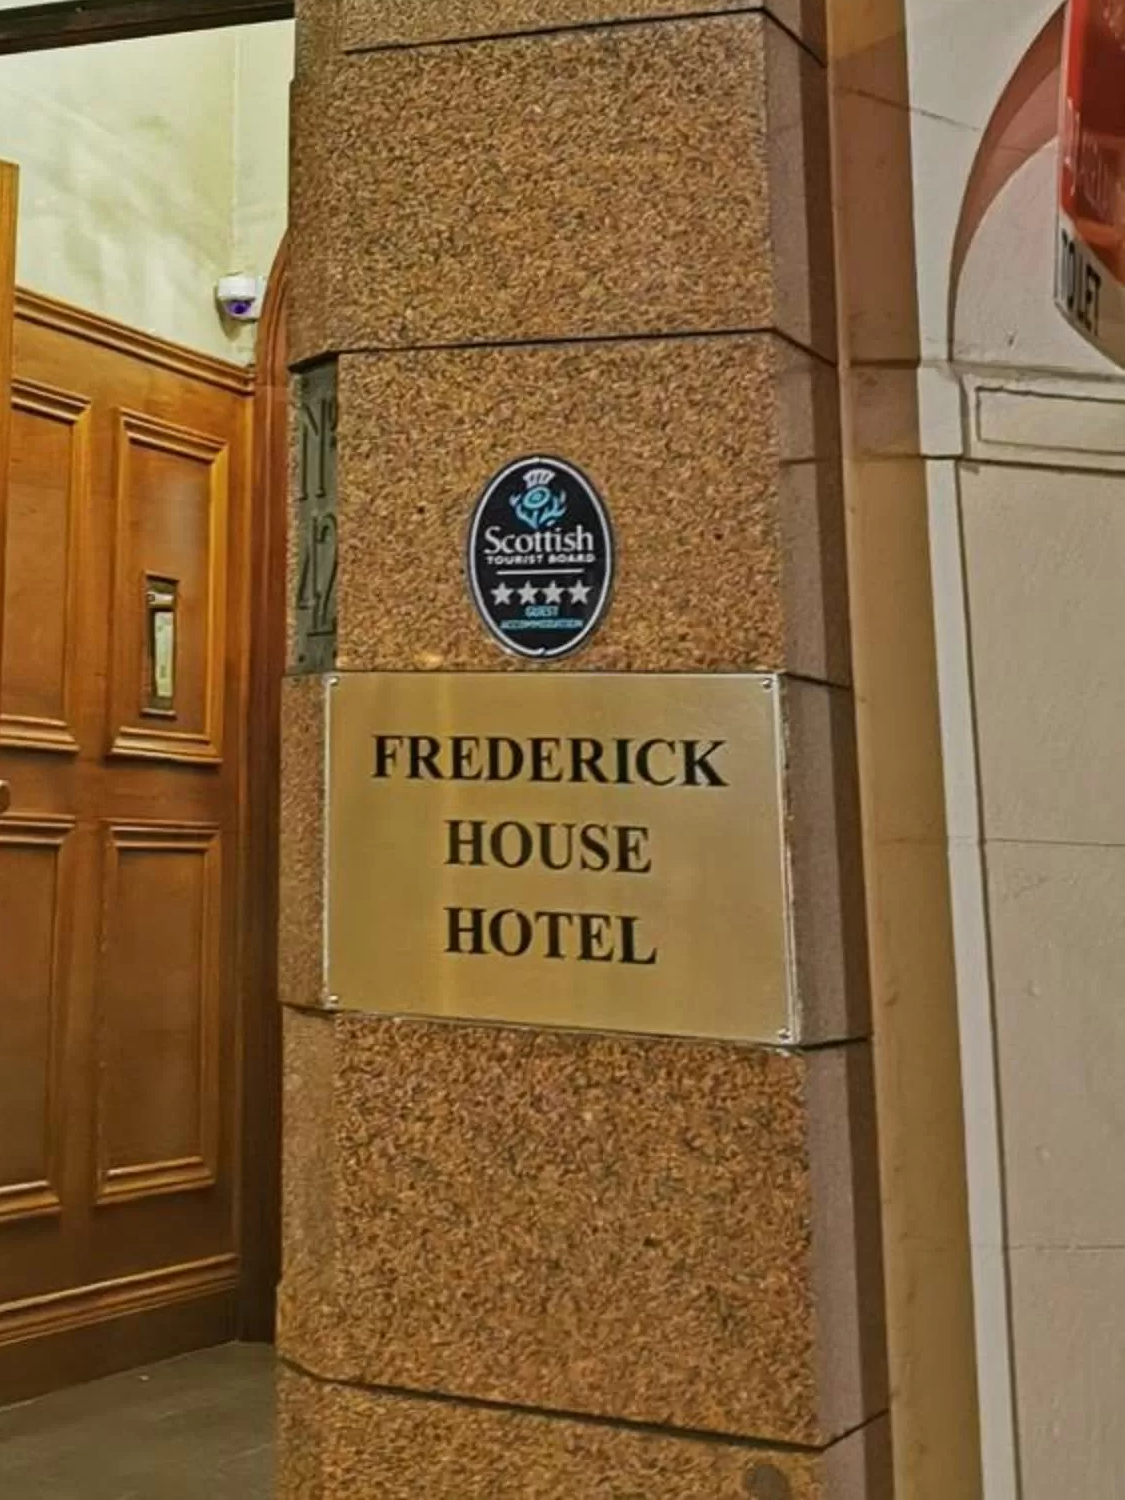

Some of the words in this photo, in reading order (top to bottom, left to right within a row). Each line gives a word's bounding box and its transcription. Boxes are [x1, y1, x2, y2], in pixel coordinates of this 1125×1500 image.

[484, 524, 594, 554] Scottish
[486, 554, 544, 565] TOURIST
[548, 553, 596, 564] BOARD
[371, 734, 729, 787] FREDERICK
[443, 819, 652, 874] HOUSE
[443, 906, 658, 966] HOTEL
